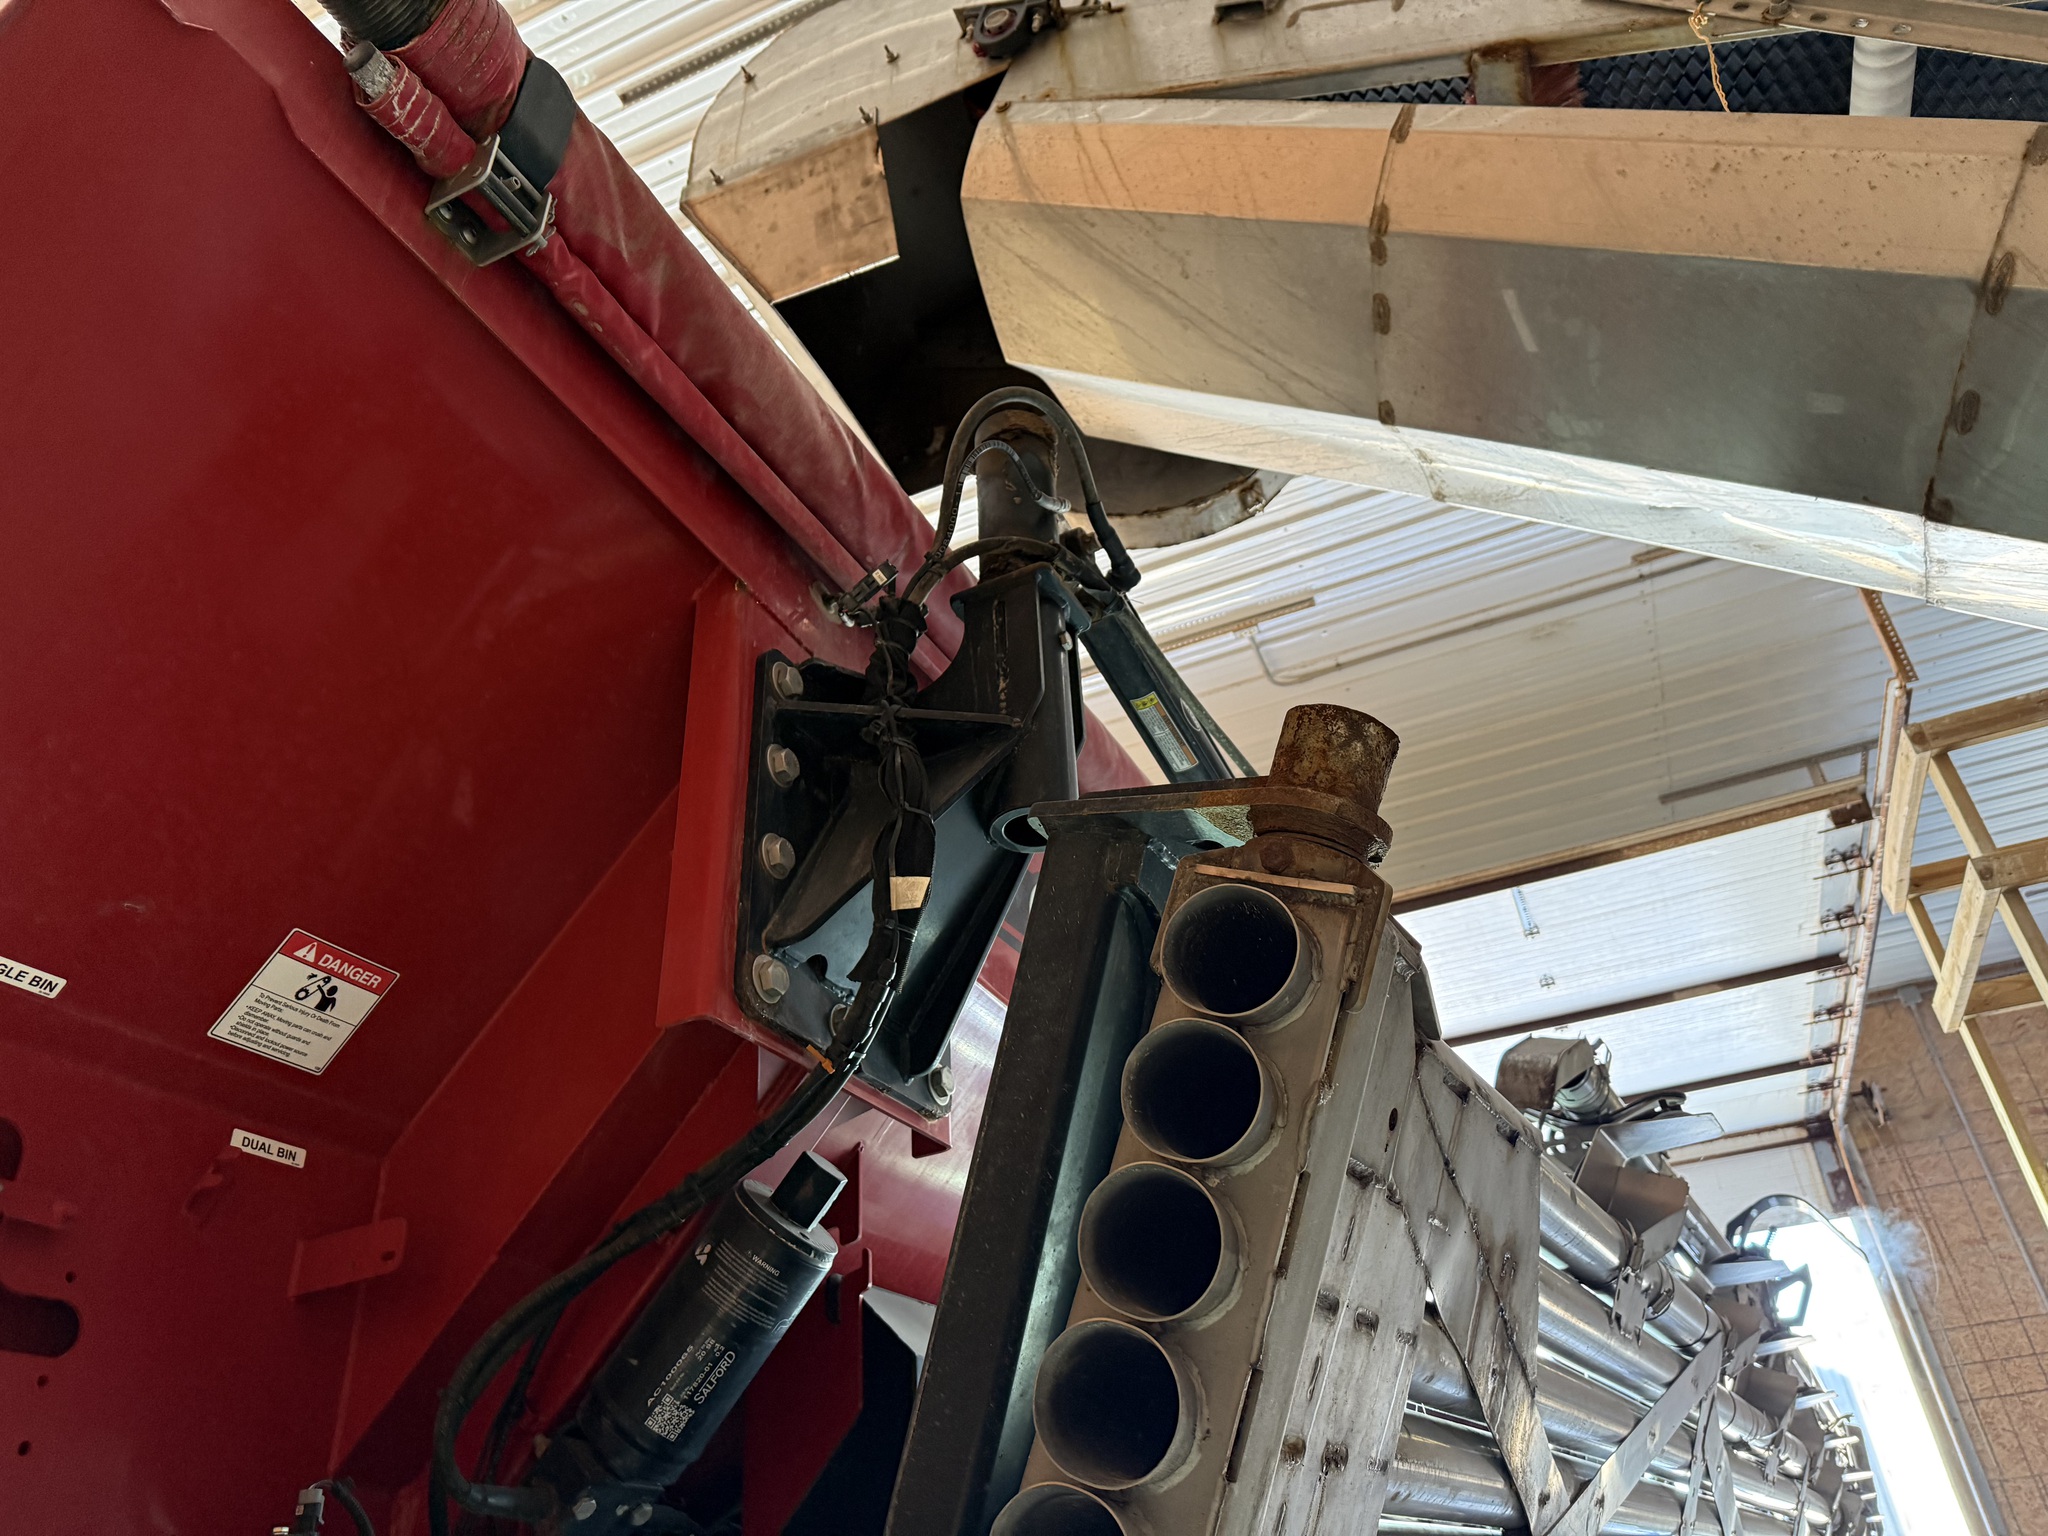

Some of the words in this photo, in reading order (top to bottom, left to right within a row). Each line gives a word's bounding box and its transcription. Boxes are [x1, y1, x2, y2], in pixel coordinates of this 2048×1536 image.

[318, 953, 382, 989] DANGER
[28, 975, 59, 993] BIN
[254, 998, 271, 1009] Moving
[265, 995, 283, 1005] Prevent
[281, 1002, 298, 1012] Serious
[298, 1008, 310, 1017] Injury
[316, 1016, 329, 1024] Death
[328, 1020, 341, 1028] From
[276, 1016, 292, 1027] Moving
[241, 1136, 274, 1156] DUAL
[276, 1146, 298, 1162] BIN
[751, 1254, 780, 1277] WARNING
[693, 1351, 736, 1405] SALFORD
